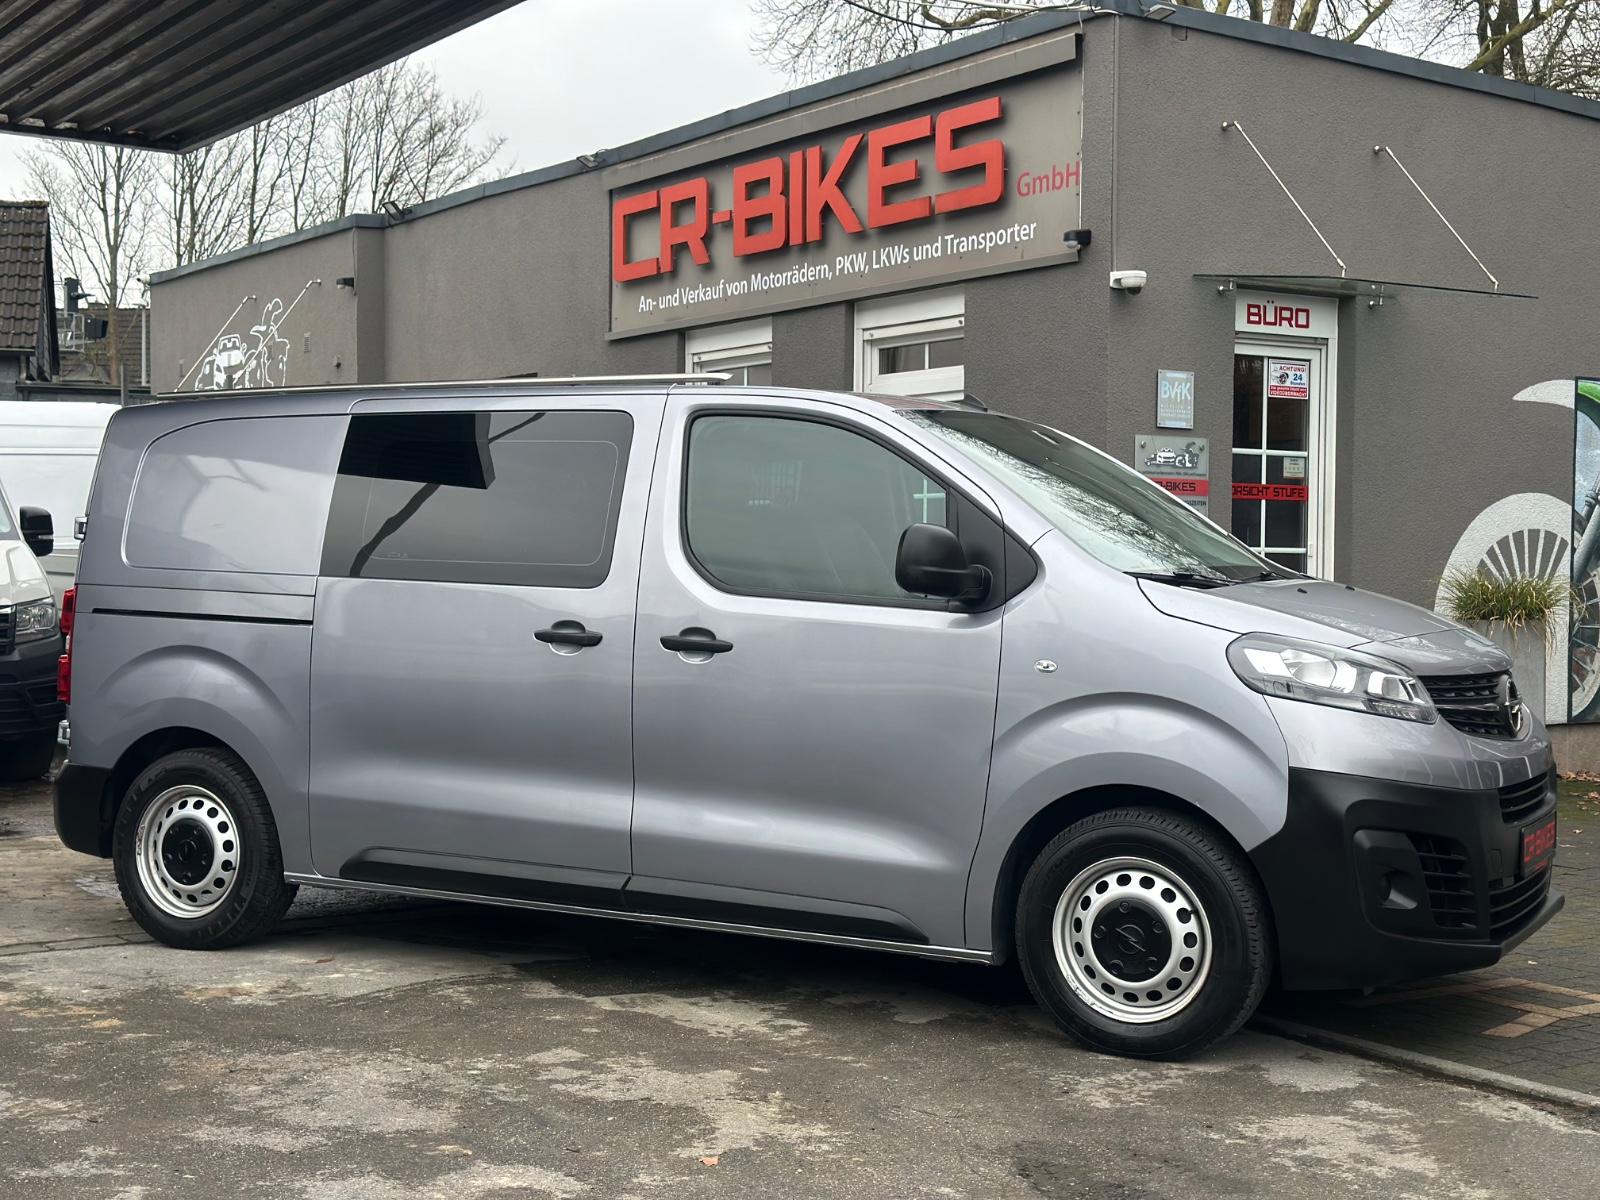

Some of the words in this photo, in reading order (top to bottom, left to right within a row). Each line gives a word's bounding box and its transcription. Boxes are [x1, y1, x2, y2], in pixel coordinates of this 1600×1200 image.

[613, 96, 1005, 284] CR-BIKES
[1016, 160, 1080, 198] GmbH
[638, 295, 657, 313] An-
[659, 288, 680, 309] und
[681, 279, 725, 305] Verkauf
[726, 280, 748, 296] von
[750, 262, 833, 293] Motorrädern,
[836, 252, 869, 276] PKW,
[872, 245, 910, 269] LKWs
[913, 235, 942, 261] und
[944, 221, 1037, 255] Transporter
[1246, 300, 1310, 329] BÜRO
[1293, 373, 1303, 381] 24
[1232, 485, 1269, 496] ORSICHT
[1273, 487, 1305, 498] STUFE
